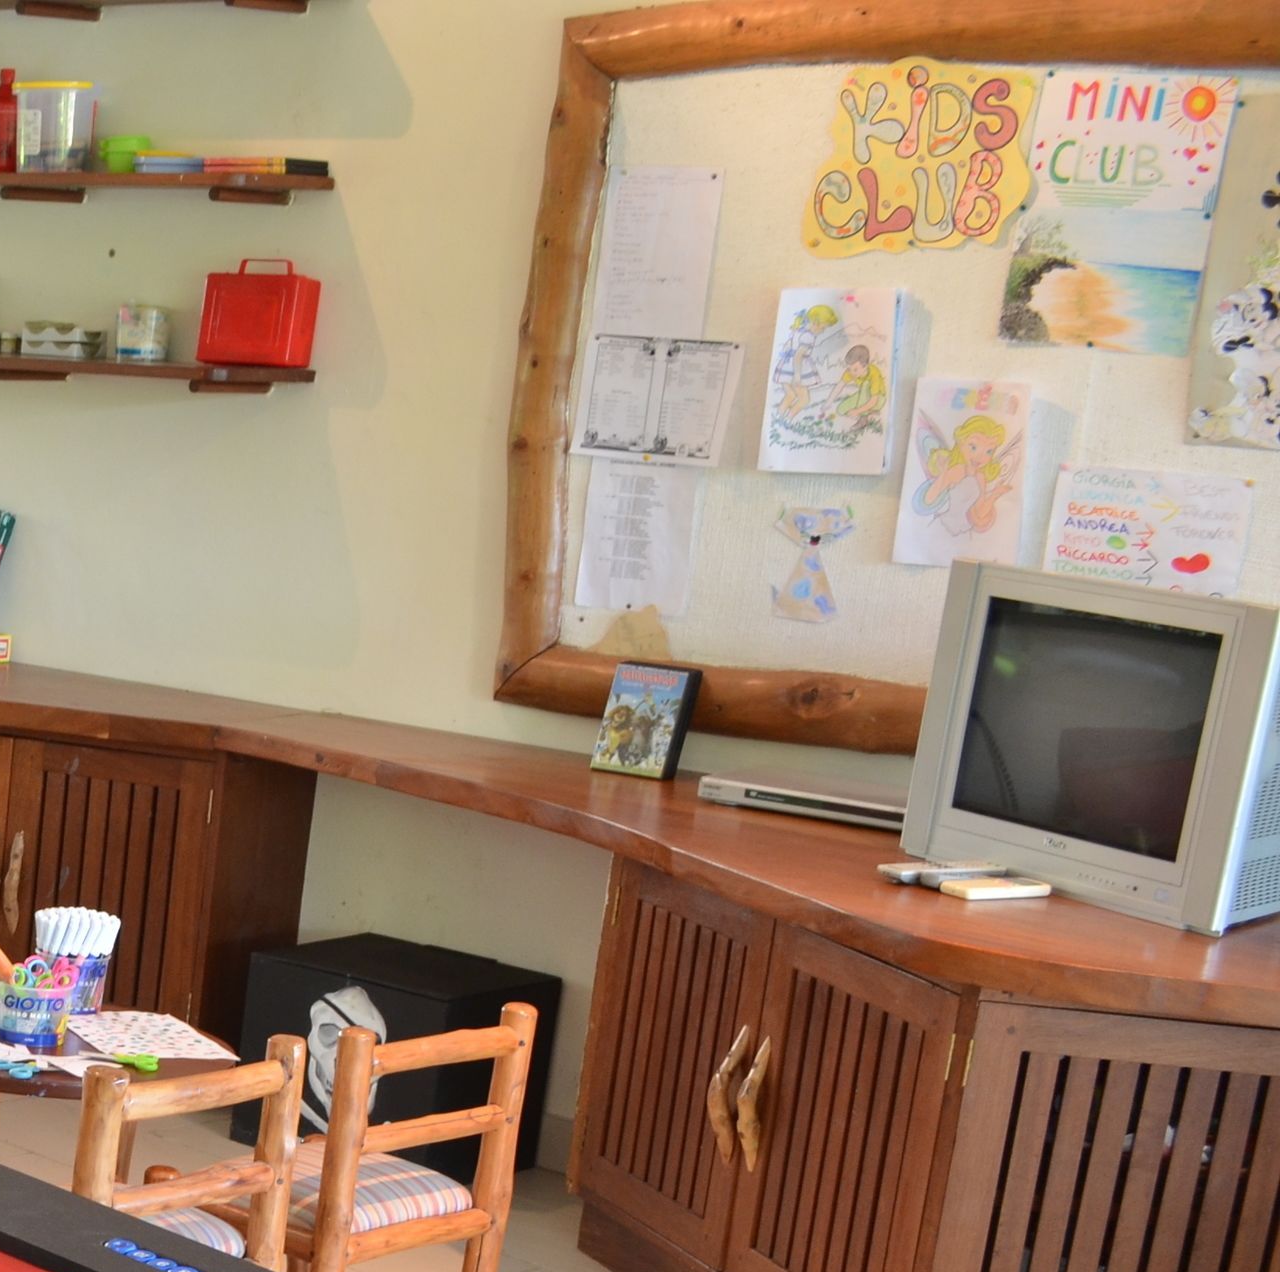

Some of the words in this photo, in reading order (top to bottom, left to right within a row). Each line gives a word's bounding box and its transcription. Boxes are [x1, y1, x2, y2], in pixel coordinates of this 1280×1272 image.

[1049, 140, 1165, 186] CLUB
[814, 150, 1004, 243] CLUB
[1067, 502, 1139, 521] BEATRICE
[1064, 516, 1131, 535] ANDREA
[1052, 559, 1133, 581] TOMMASO
[4, 995, 65, 1011] GIOTTO
